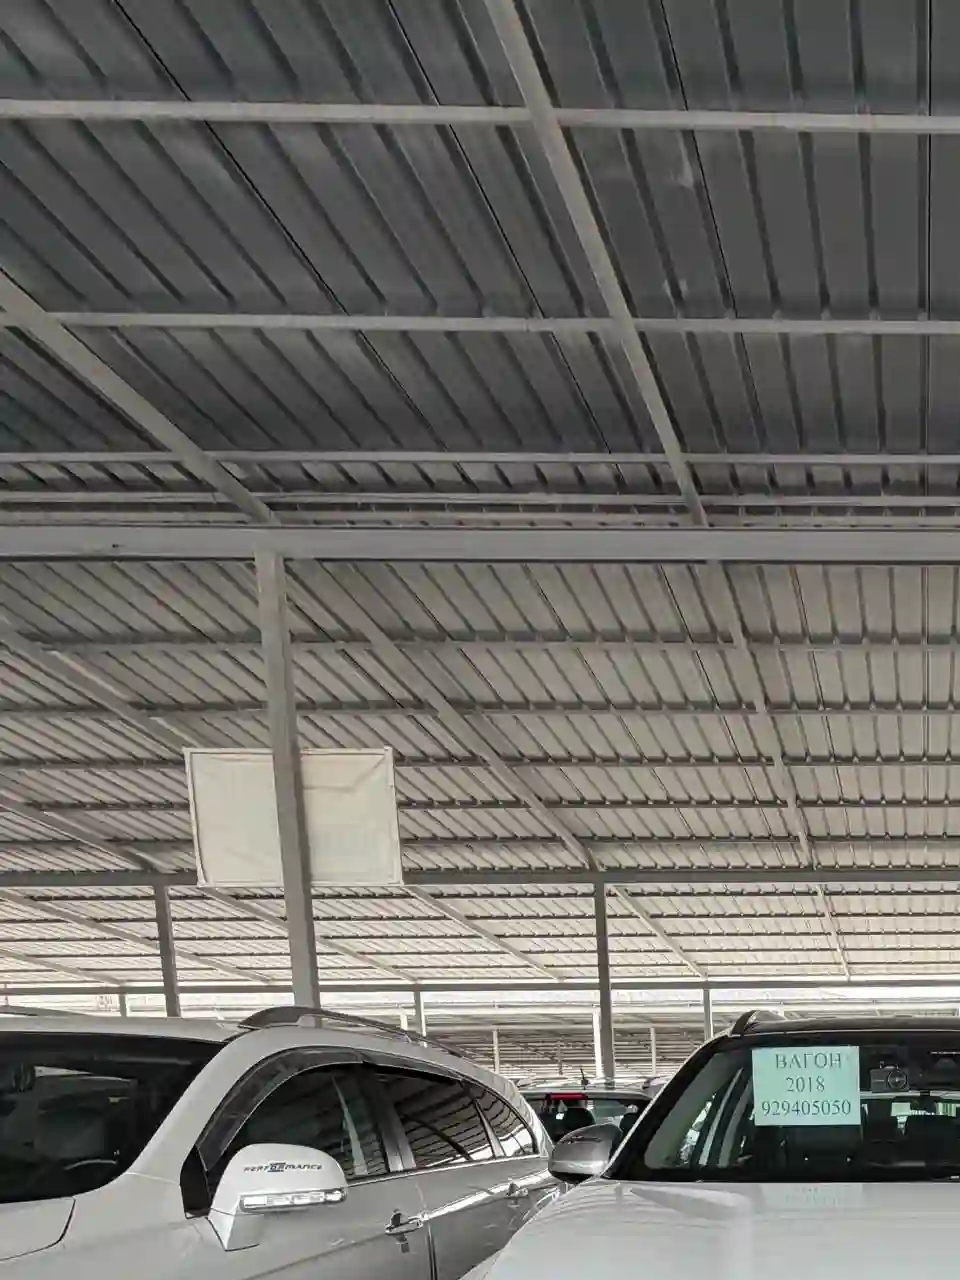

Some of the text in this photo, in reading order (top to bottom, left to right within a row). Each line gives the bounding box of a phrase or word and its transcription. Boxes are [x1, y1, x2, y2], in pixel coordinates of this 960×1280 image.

[775, 1053, 842, 1069] ВАГОН
[785, 1076, 825, 1093] 2018
[761, 1100, 852, 1117] 929405050
